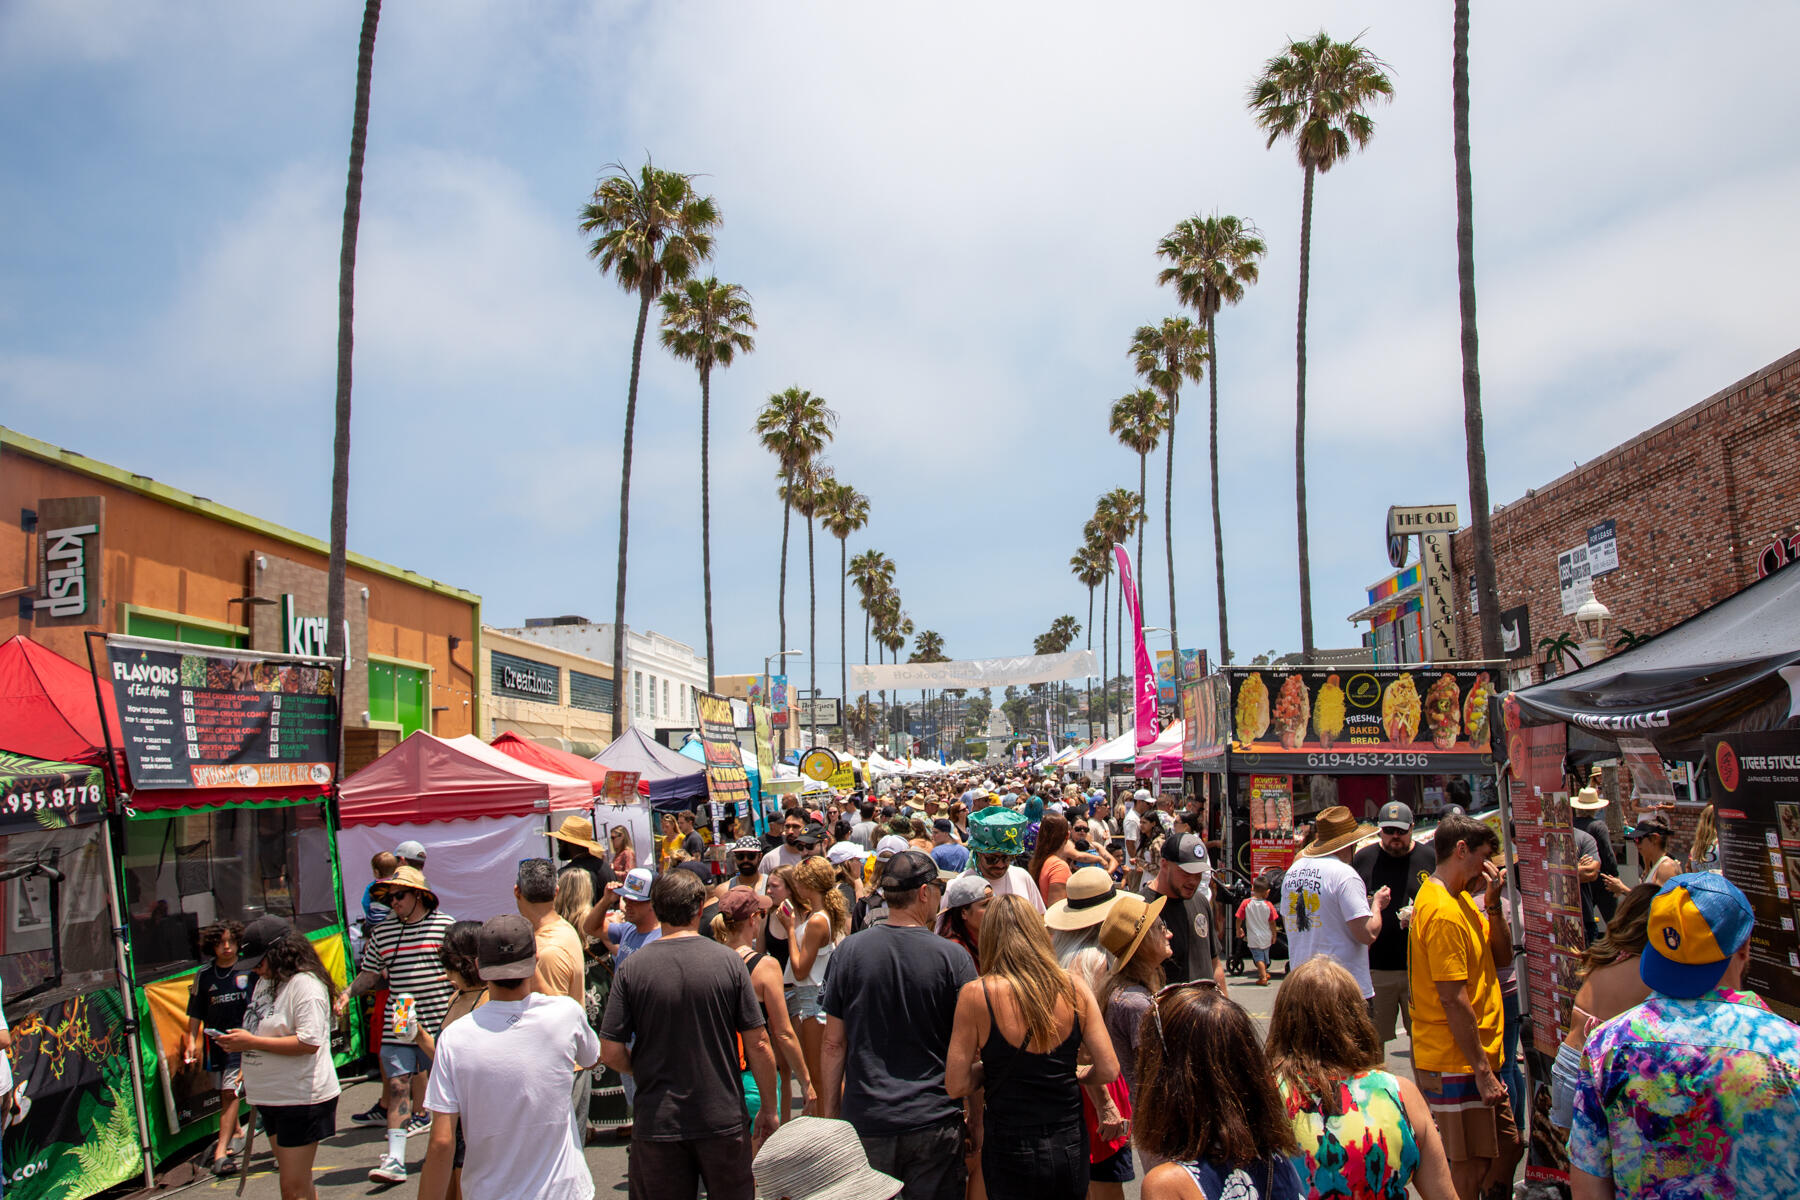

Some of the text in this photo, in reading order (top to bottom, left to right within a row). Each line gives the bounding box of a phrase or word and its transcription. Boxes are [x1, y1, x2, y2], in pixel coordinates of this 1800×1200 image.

[1397, 511, 1456, 526] THE OLD
[1590, 528, 1614, 545] FOR LEASE
[33, 524, 99, 617] krisp
[1425, 535, 1457, 658] OCEAN BEACH CAFE
[287, 594, 352, 671] kri
[112, 661, 179, 685] FLAVORS
[504, 665, 553, 695] Creations
[127, 684, 170, 700] of East Africa
[184, 691, 193, 705] 22
[193, 692, 211, 700] LARGE
[211, 693, 236, 701] CHICKEN
[127, 704, 168, 715] HOW TO ORDER:
[194, 709, 219, 717] MEDIUM
[1345, 714, 1383, 725] FRESHLY
[1573, 709, 1670, 730] TIGER STICKS
[196, 726, 214, 735] SMALL
[215, 727, 240, 736] CHICKEN
[1350, 727, 1380, 735] BAKED
[223, 744, 241, 752] BOWL
[1350, 736, 1380, 745] BREAD
[1306, 753, 1429, 768] 619-453-2196
[1740, 755, 1800, 770] TIGER STICKS
[193, 766, 236, 787] SAMBUSAS
[260, 766, 279, 783] EACH
[279, 766, 290, 783] OR
[297, 766, 309, 781] FOR
[713, 766, 748, 782] GYROS
[1747, 775, 1799, 783] JAPANESE SKEWERS
[1299, 868, 1321, 879] FINAL
[211, 991, 248, 1006] DIRECTV
